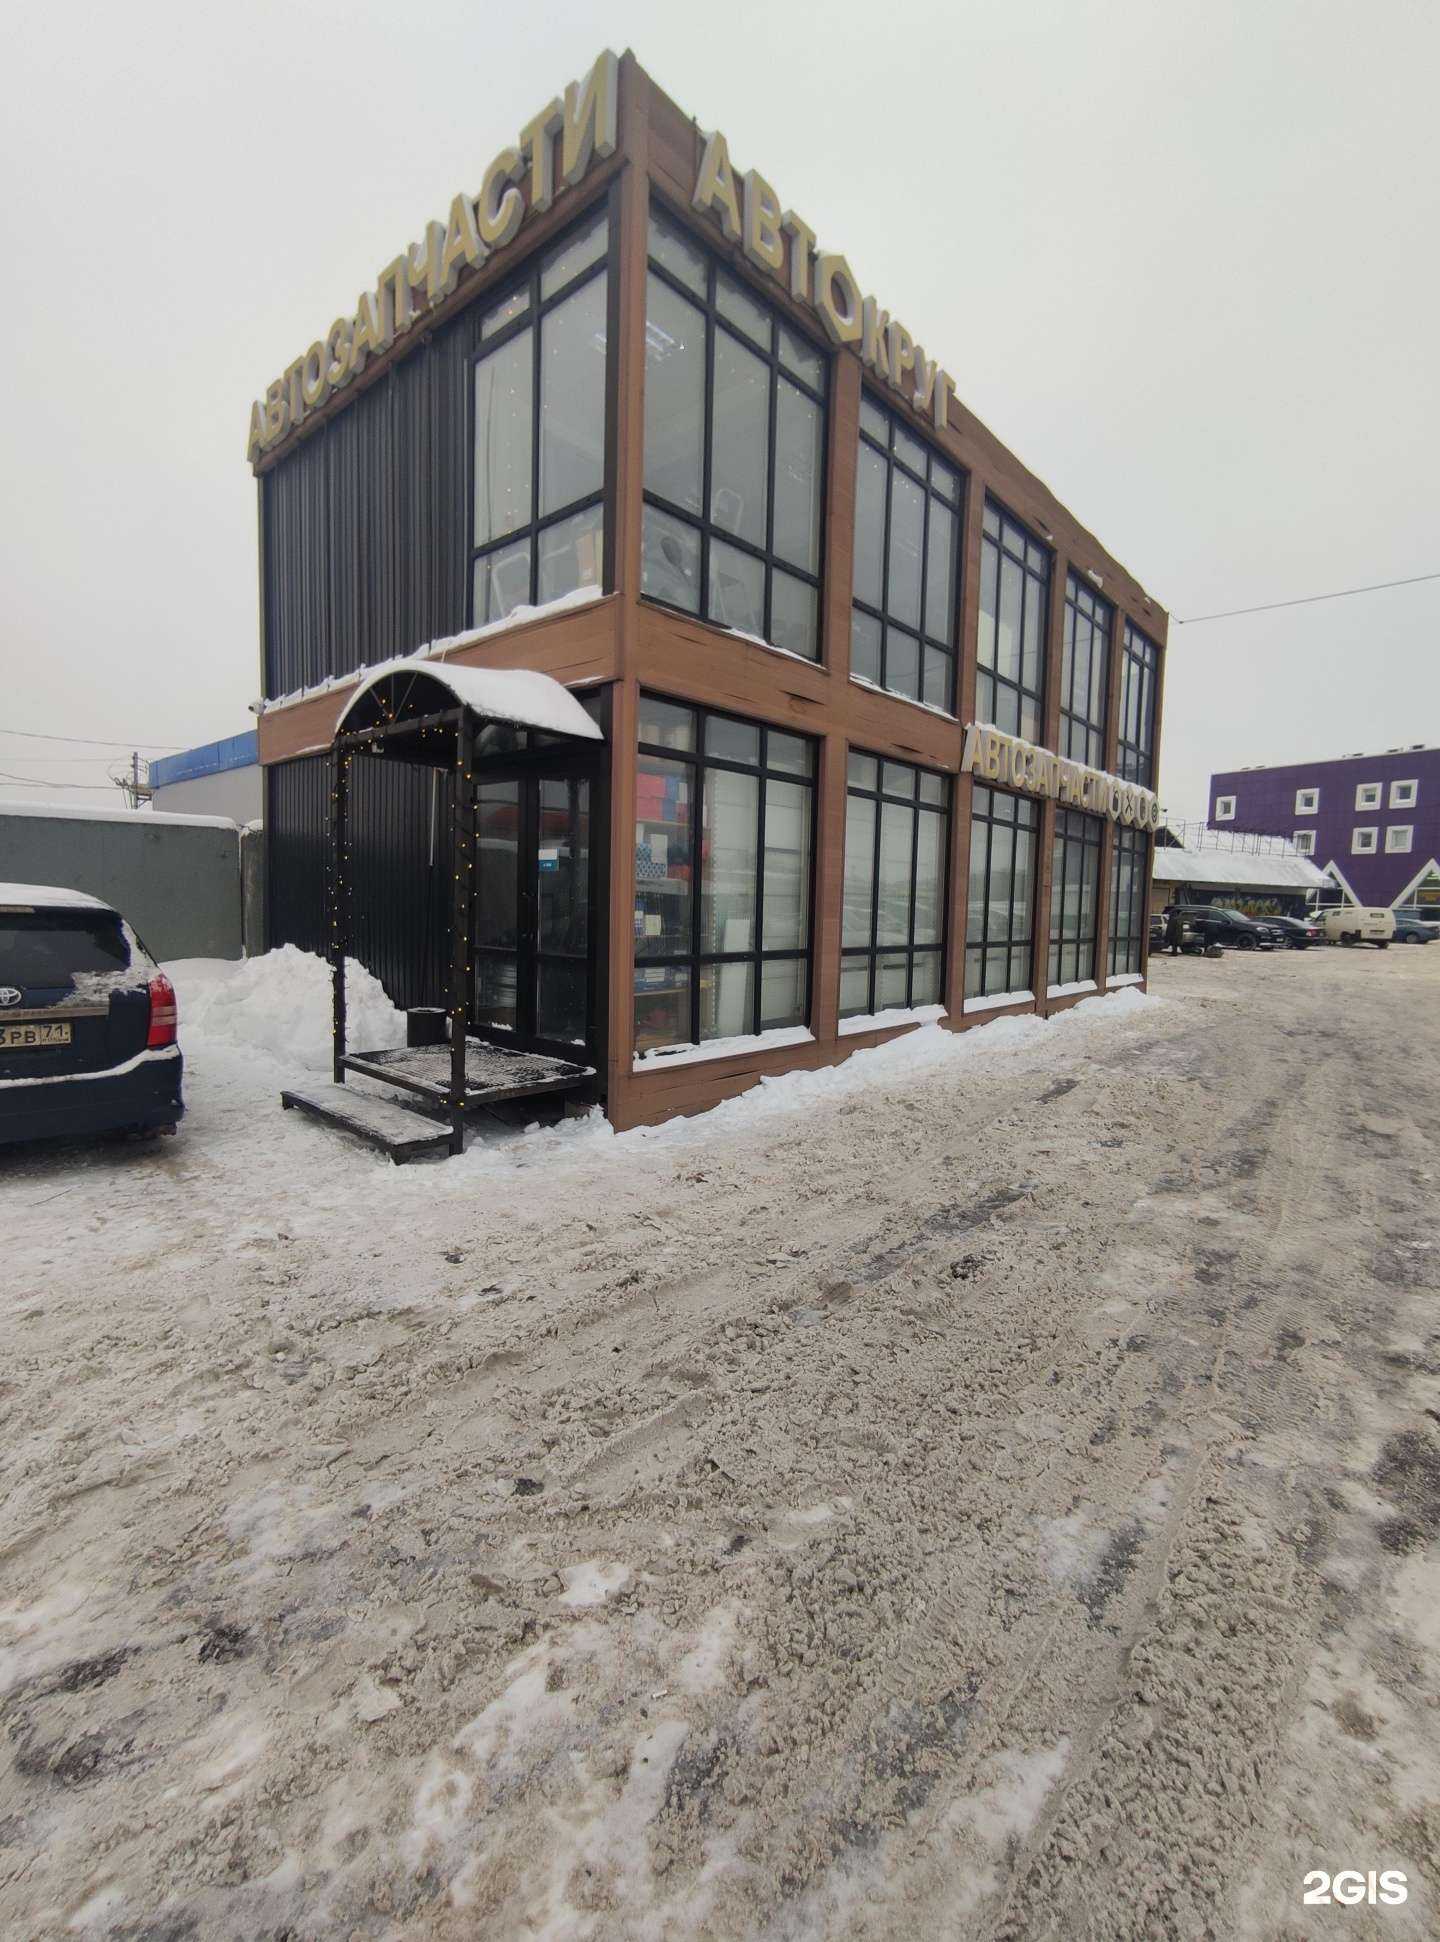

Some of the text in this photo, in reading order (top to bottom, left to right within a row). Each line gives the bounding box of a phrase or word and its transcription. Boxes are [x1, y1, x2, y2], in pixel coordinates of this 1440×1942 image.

[247, 48, 619, 463] АВТОЗАПЧАСТИ
[691, 130, 956, 431] АВТОКРУГ
[961, 725, 1109, 814] АВТОЗАПЧАСТИ
